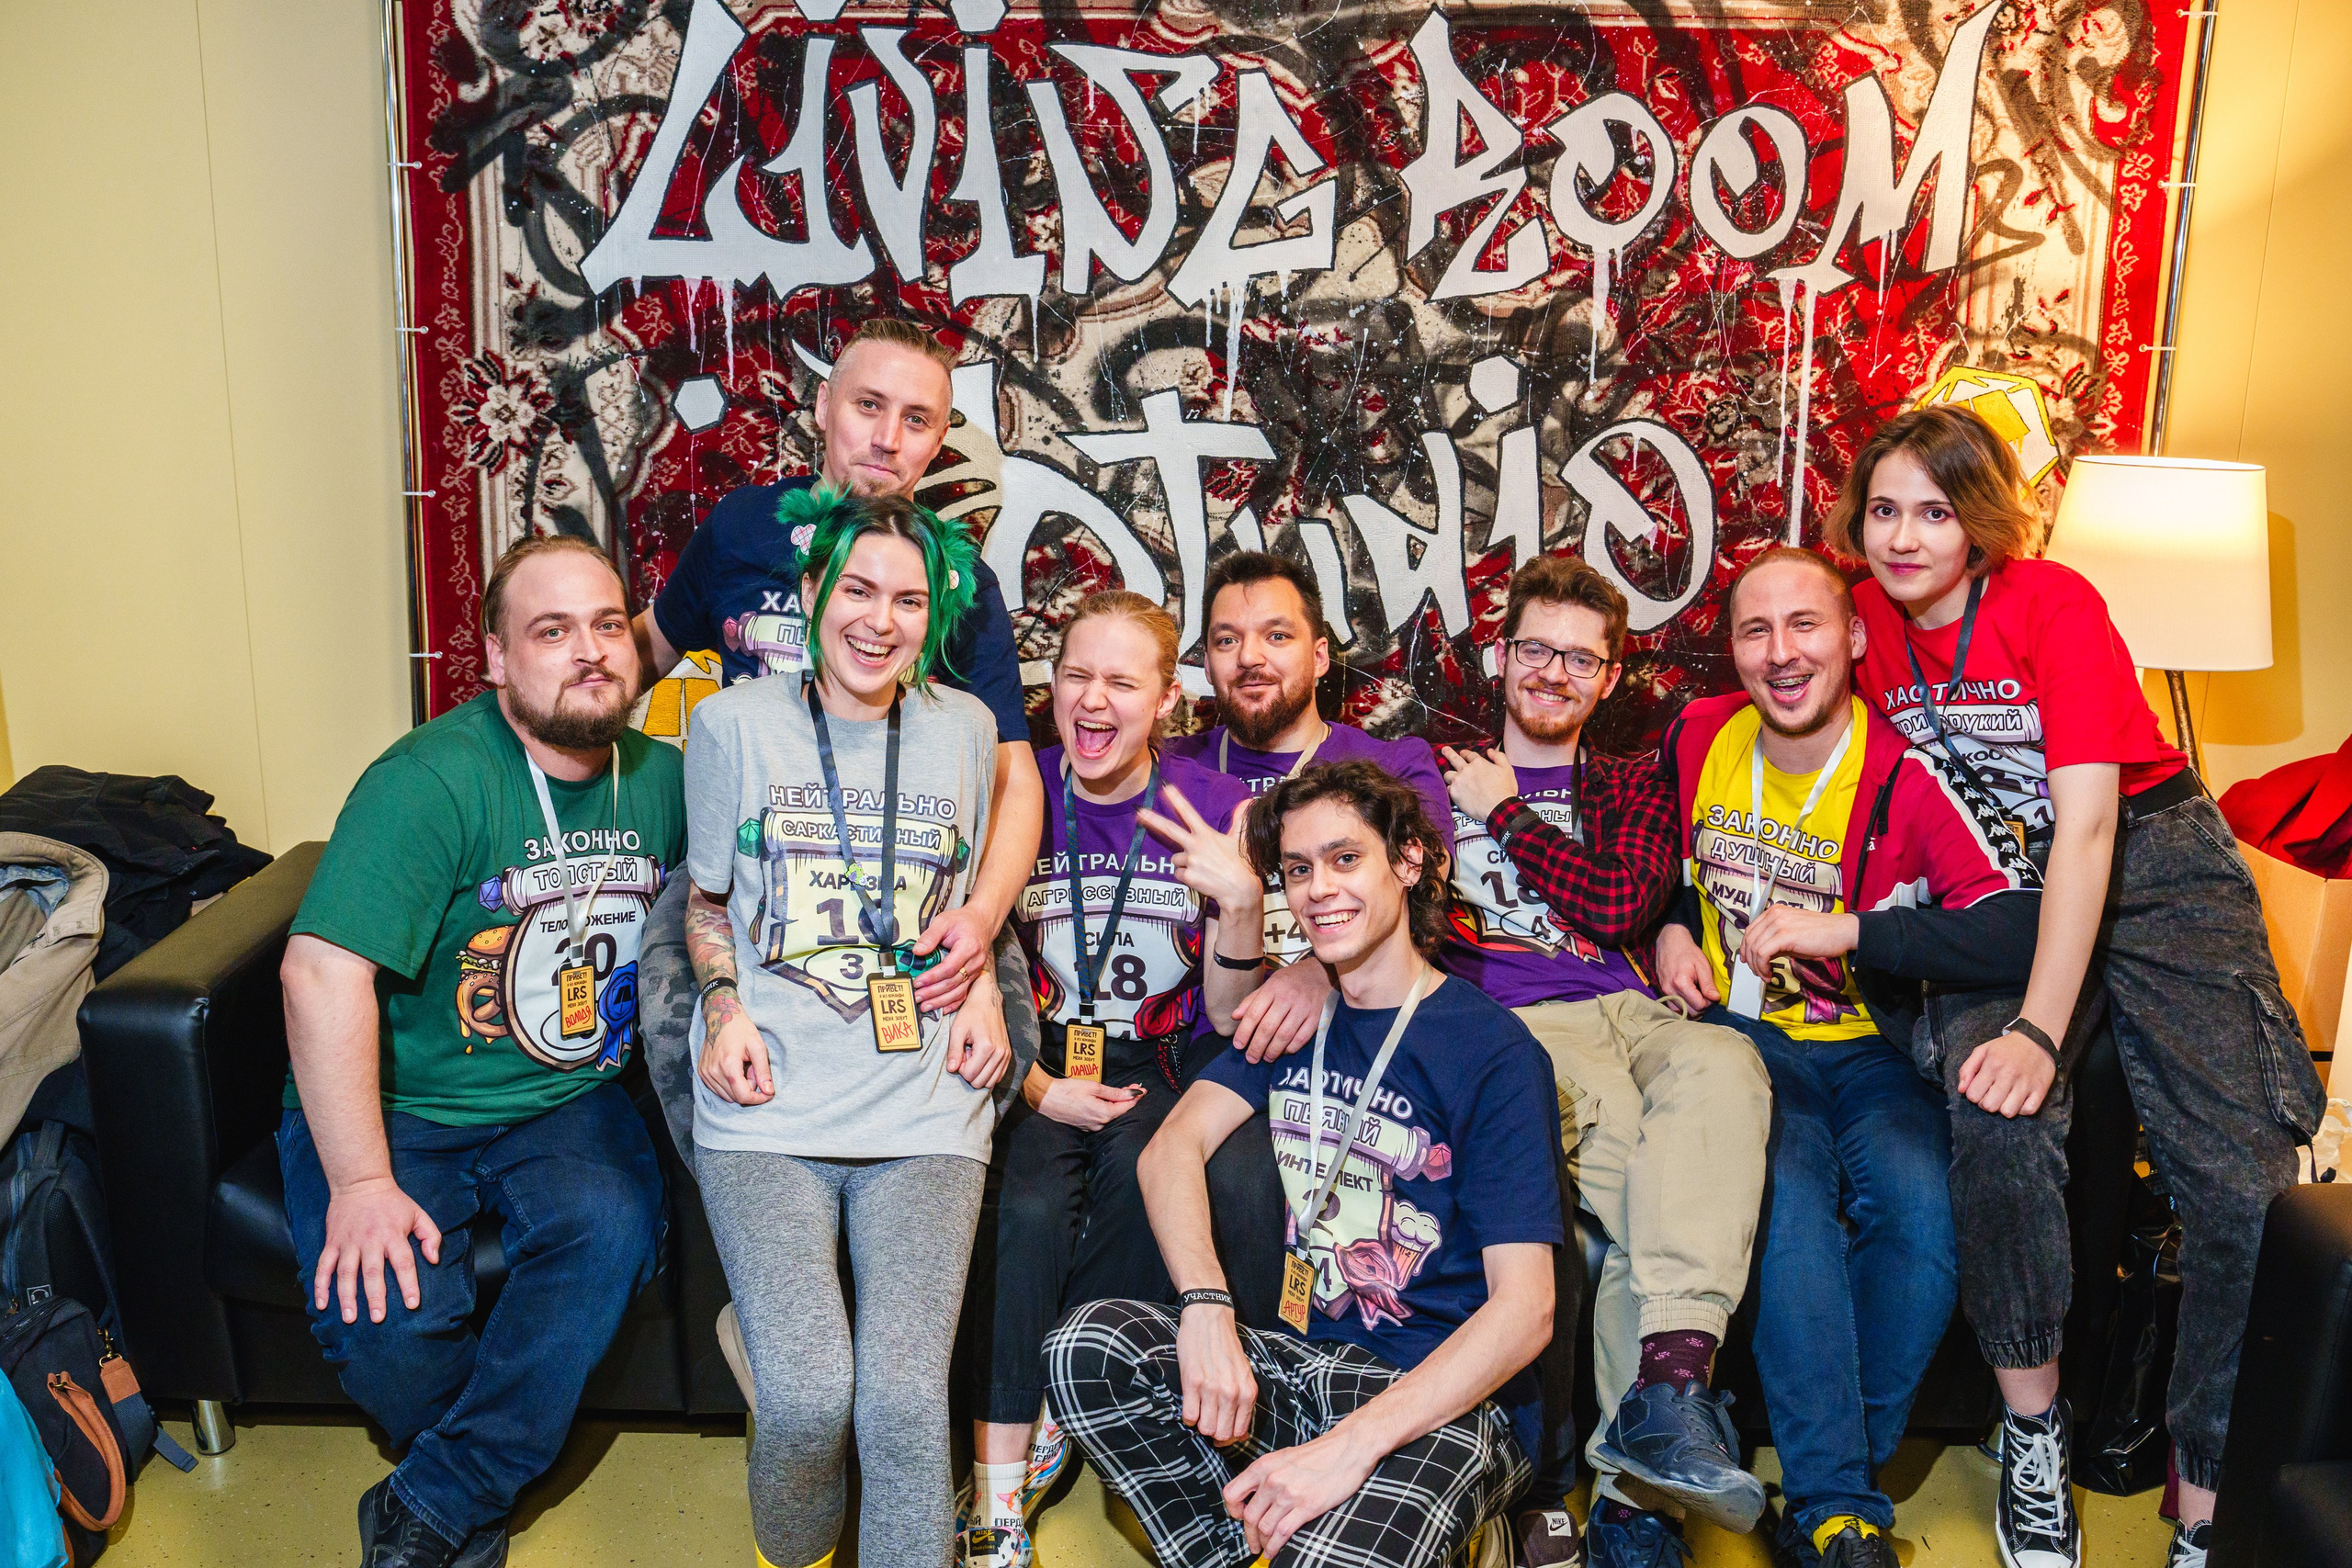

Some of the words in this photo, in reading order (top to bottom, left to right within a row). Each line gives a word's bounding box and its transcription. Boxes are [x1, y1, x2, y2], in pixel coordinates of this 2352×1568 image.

[1398, 2, 2006, 300] ROOM
[1711, 837, 1815, 885] ДУШНЫЙ
[567, 972, 587, 982] ПРИВЕТ!
[840, 953, 864, 980] 3
[567, 986, 587, 1001] LRS
[877, 985, 903, 993] ПРИВЕТ!
[565, 1005, 592, 1028] ВОЛОДЯ
[880, 998, 907, 1014] LRS
[881, 1021, 914, 1043] ВИКА
[1073, 1042, 1095, 1055] LRS
[1068, 1063, 1099, 1077] МАША
[1289, 1275, 1306, 1296] LRS
[1283, 1300, 1306, 1323] АРТУР
